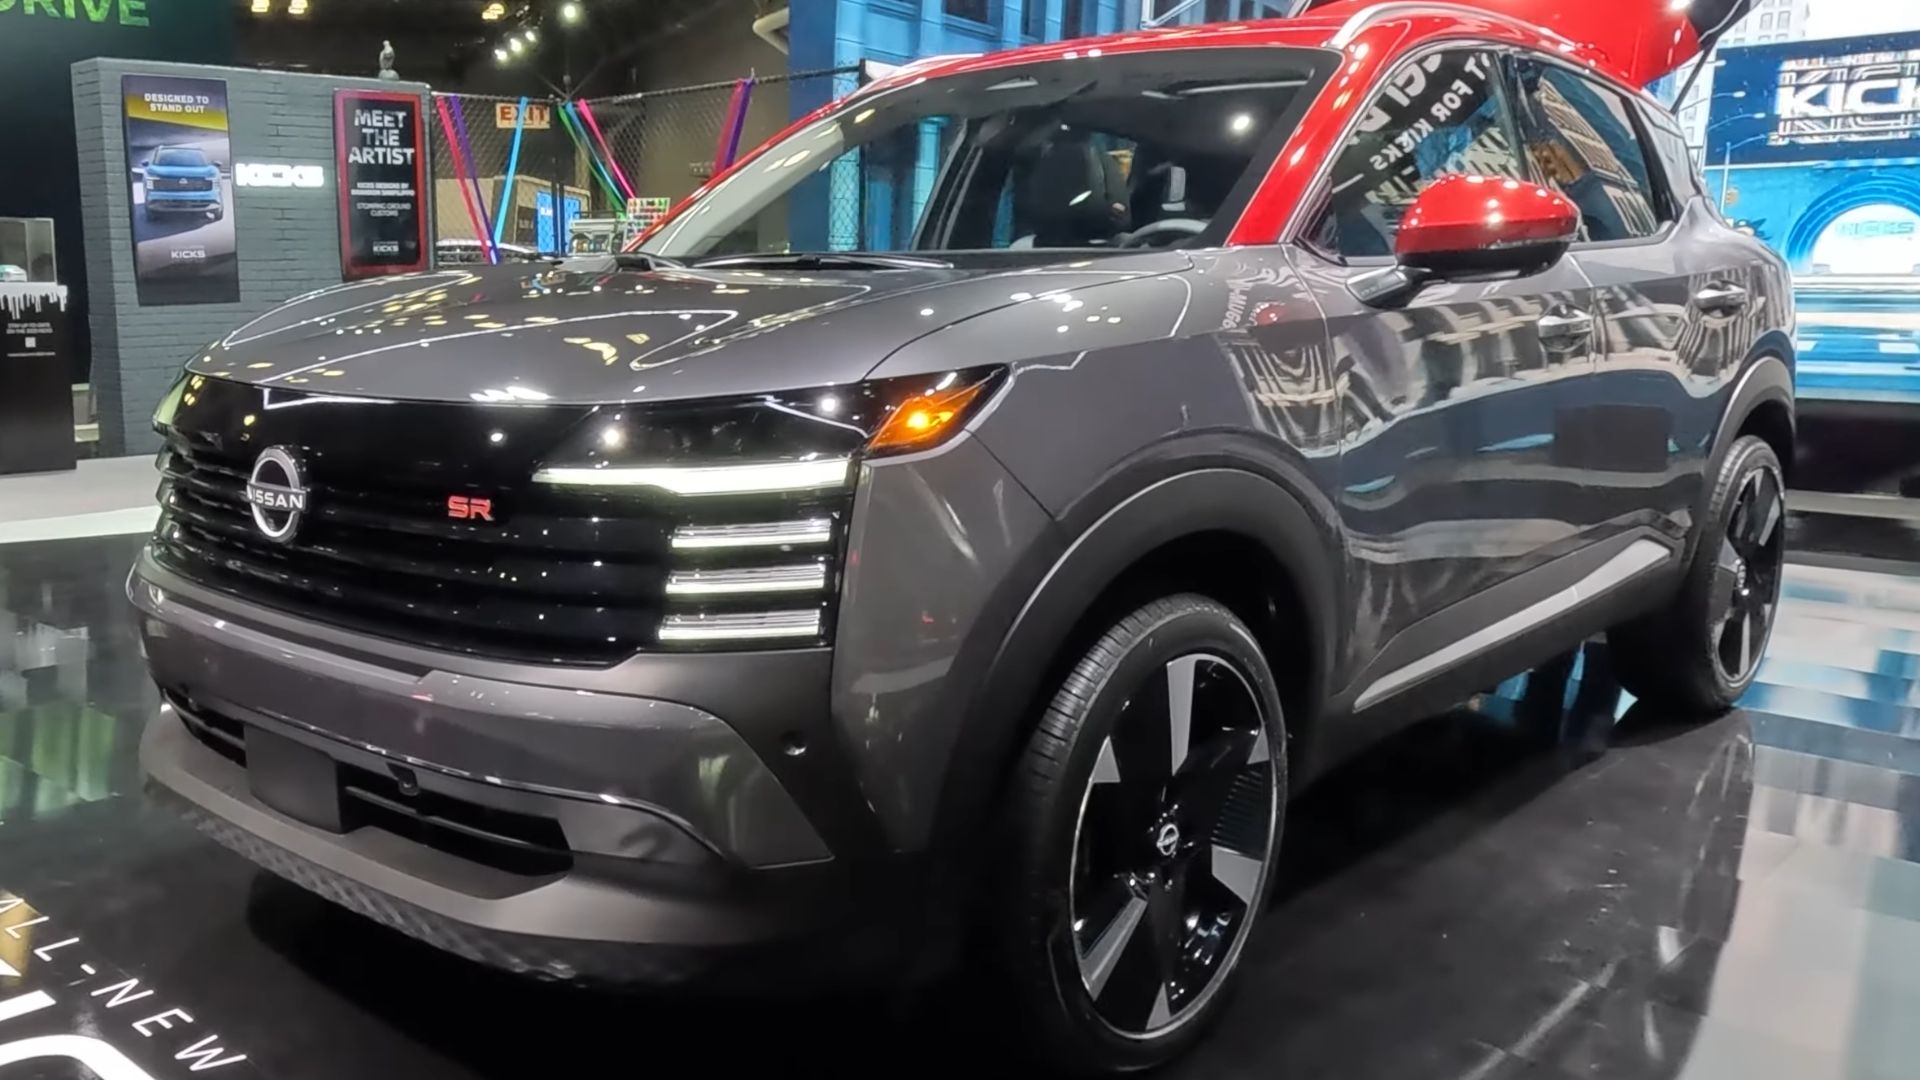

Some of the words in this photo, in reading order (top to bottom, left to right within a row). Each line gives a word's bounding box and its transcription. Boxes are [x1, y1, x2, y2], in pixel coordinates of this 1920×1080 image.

[0, 0, 149, 27] IVE
[144, 93, 194, 103] DESIGNED
[195, 96, 209, 104] TO
[150, 103, 182, 112] STAND
[185, 105, 205, 113] OUT
[354, 109, 407, 128] MEET
[361, 128, 400, 146] THE
[348, 146, 415, 165] ARTIST
[171, 250, 206, 259] KICKS
[448, 496, 494, 521] SR
